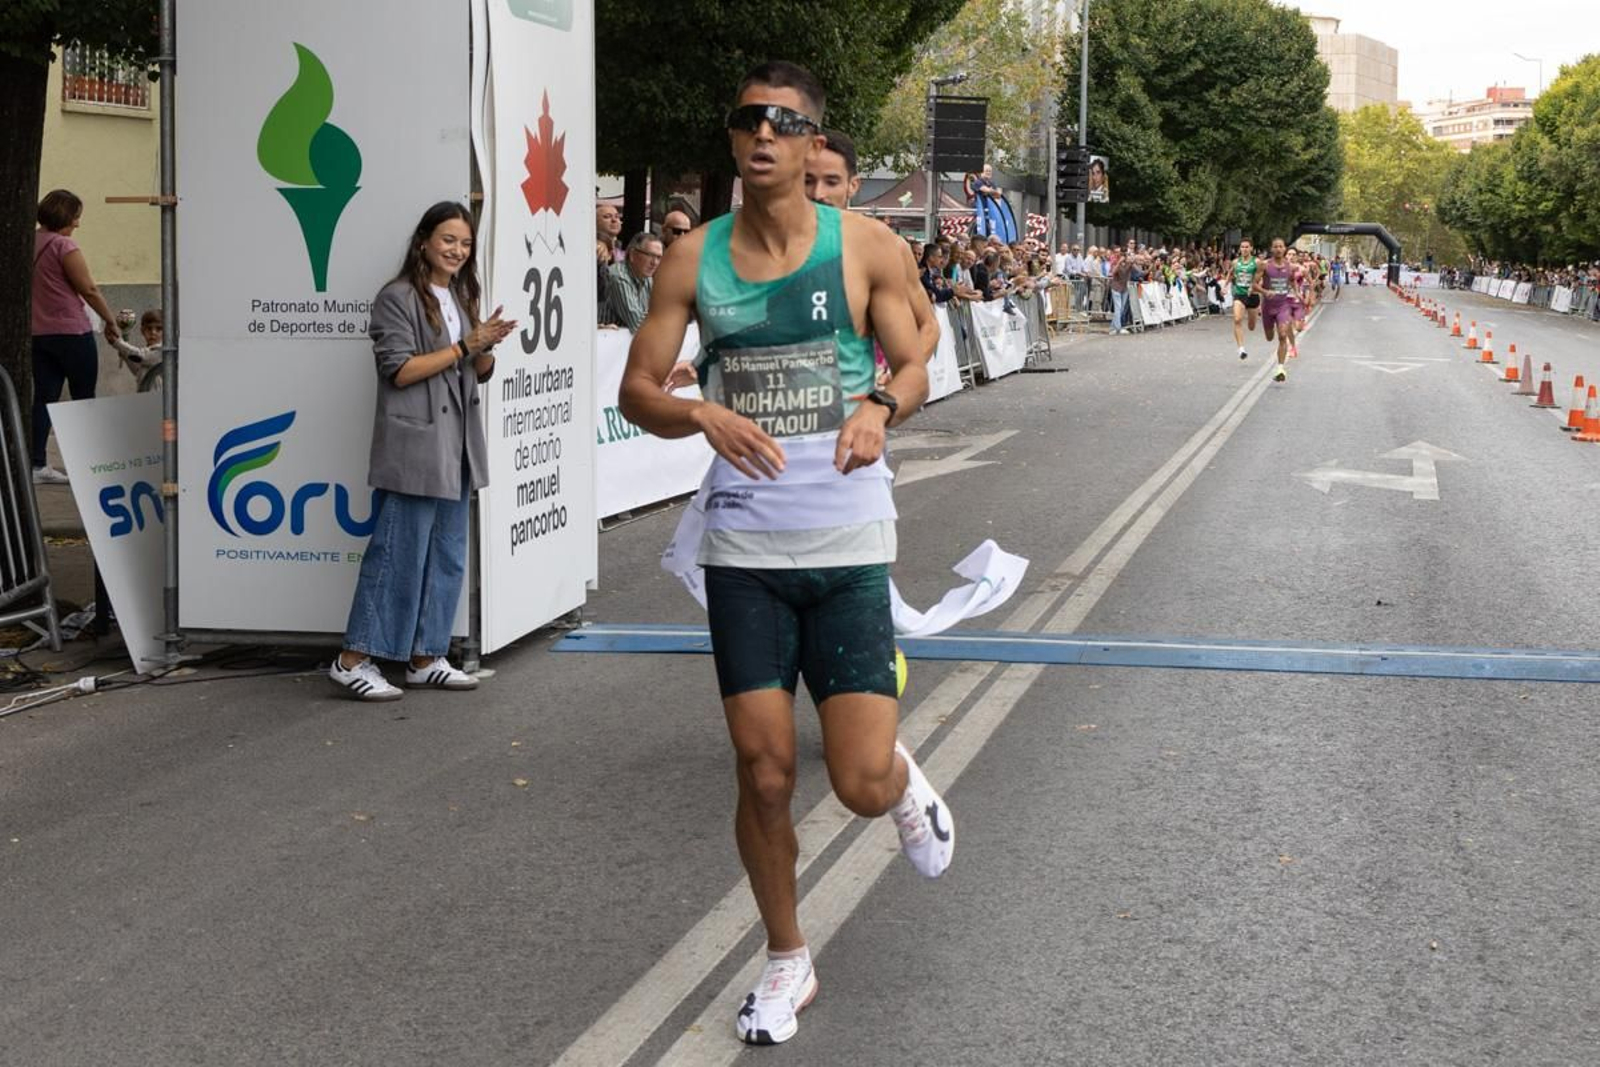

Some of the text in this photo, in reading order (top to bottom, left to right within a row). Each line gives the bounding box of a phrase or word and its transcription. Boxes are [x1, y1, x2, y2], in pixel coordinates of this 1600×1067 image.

[251, 299, 374, 316] Patronato Municip
[520, 266, 564, 354] 36
[247, 319, 368, 337] de Deportes de J
[724, 356, 739, 373] 36
[741, 357, 780, 373] Manuel
[782, 353, 835, 371] Pancorbo
[502, 363, 574, 401] milla urbana
[766, 372, 786, 390] 11
[731, 384, 834, 414] MOHAMED
[502, 393, 573, 438] internacional
[755, 412, 819, 435] TTAOUI
[514, 438, 530, 471] de
[530, 432, 562, 467] otoño
[207, 410, 384, 538] Foru
[516, 464, 561, 508] manuel
[510, 502, 568, 556] pancorbo
[215, 549, 341, 563] POSITIVAMENTE
